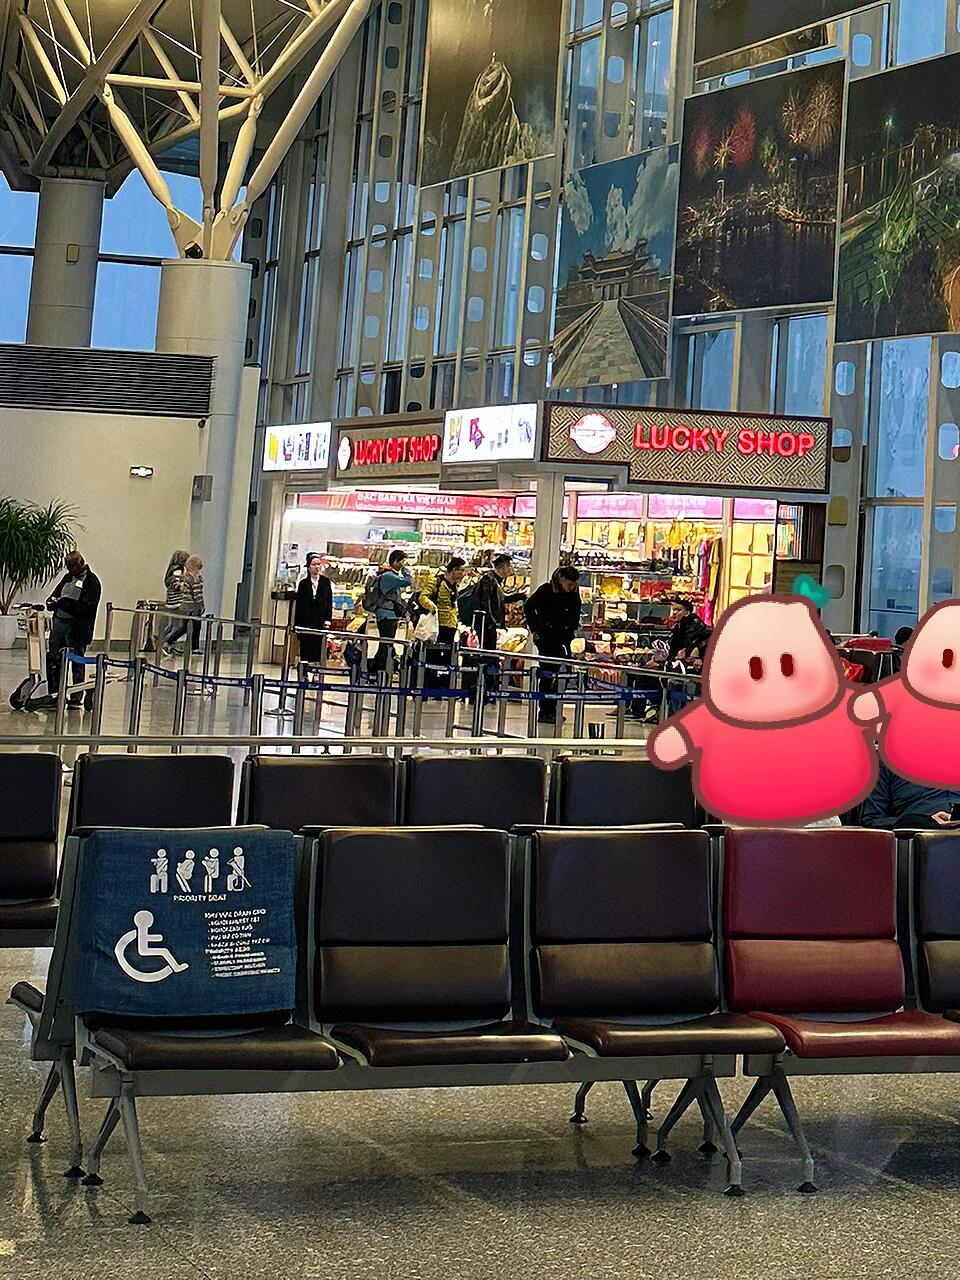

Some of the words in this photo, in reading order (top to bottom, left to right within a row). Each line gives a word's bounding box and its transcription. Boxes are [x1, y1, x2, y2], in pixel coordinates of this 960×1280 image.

[354, 439, 385, 466] LUCKY
[409, 434, 439, 462] SHOP
[634, 423, 729, 453] LUCKY
[736, 428, 816, 458] SHOP
